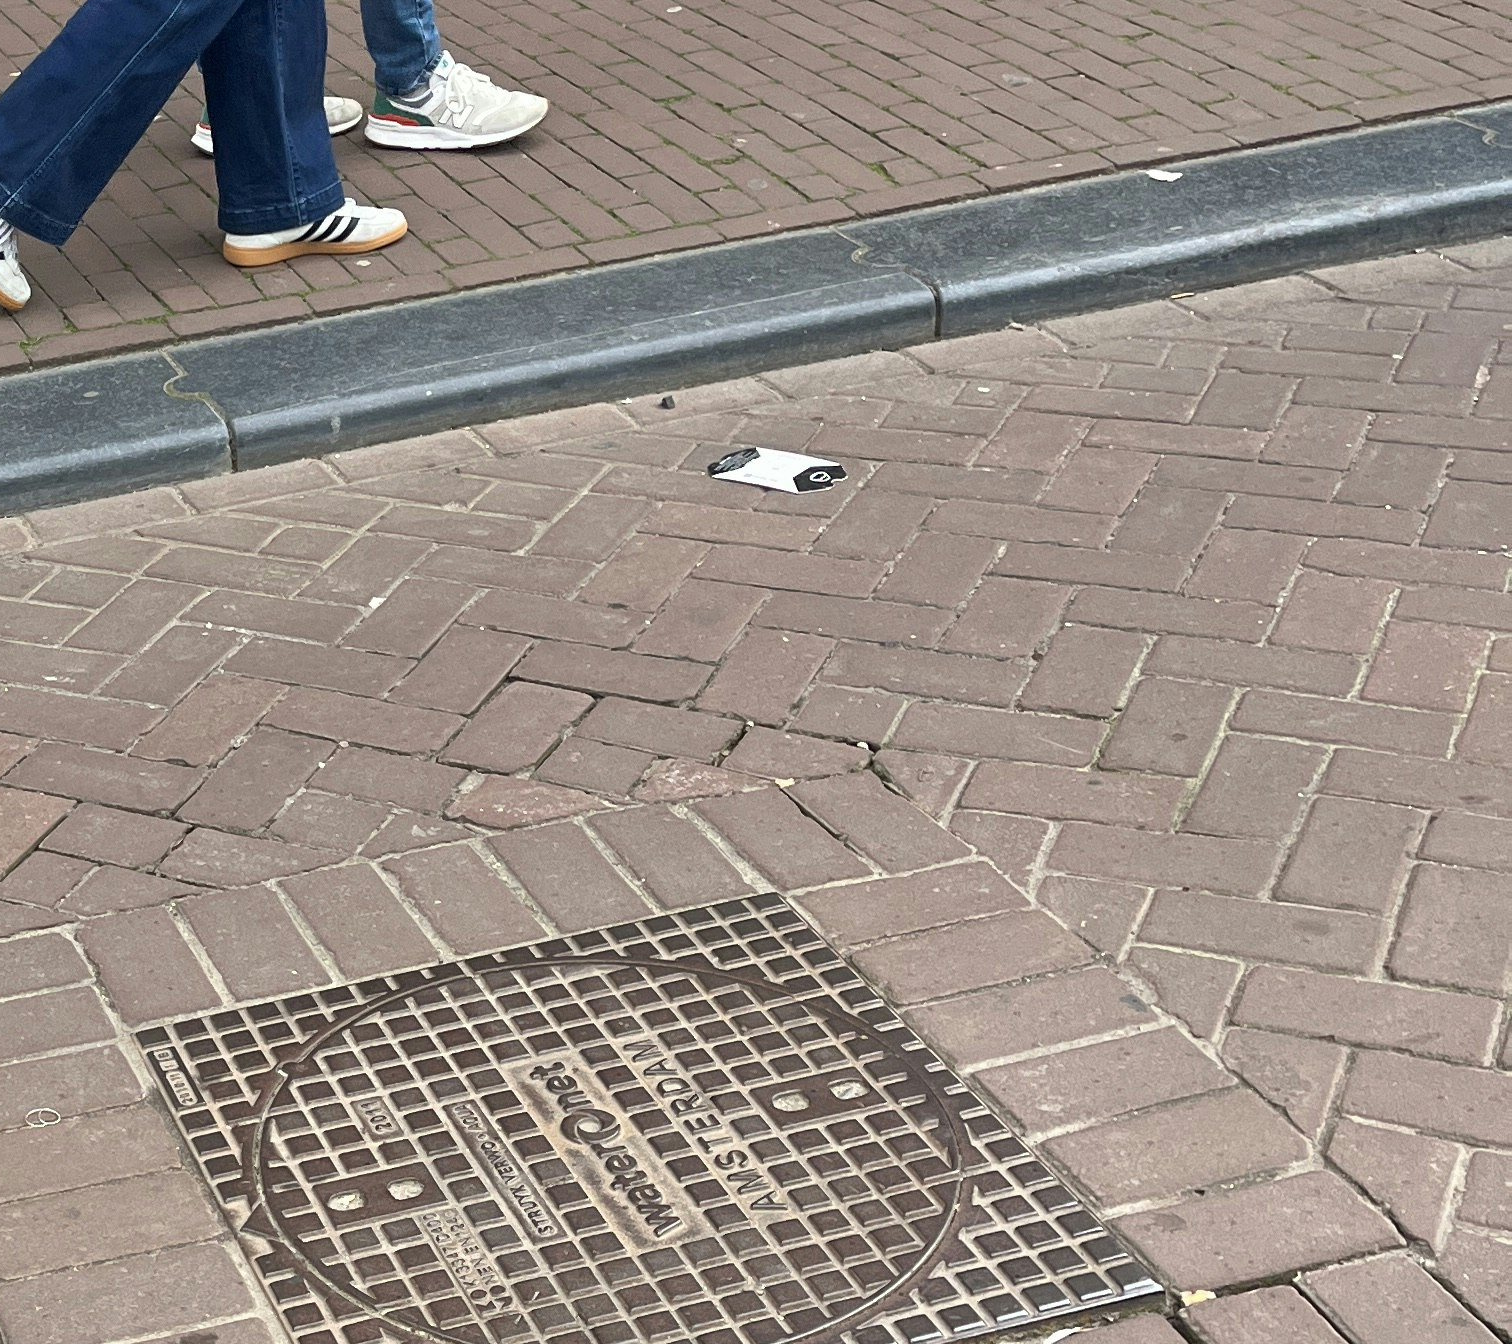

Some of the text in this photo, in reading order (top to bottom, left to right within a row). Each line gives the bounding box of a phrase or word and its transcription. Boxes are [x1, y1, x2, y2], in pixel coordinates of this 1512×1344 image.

[361, 1101, 393, 1132] 2011
[453, 1103, 556, 1234] STRUYK VERWO AQUA
[622, 1038, 788, 1214] AMSTERDAM
